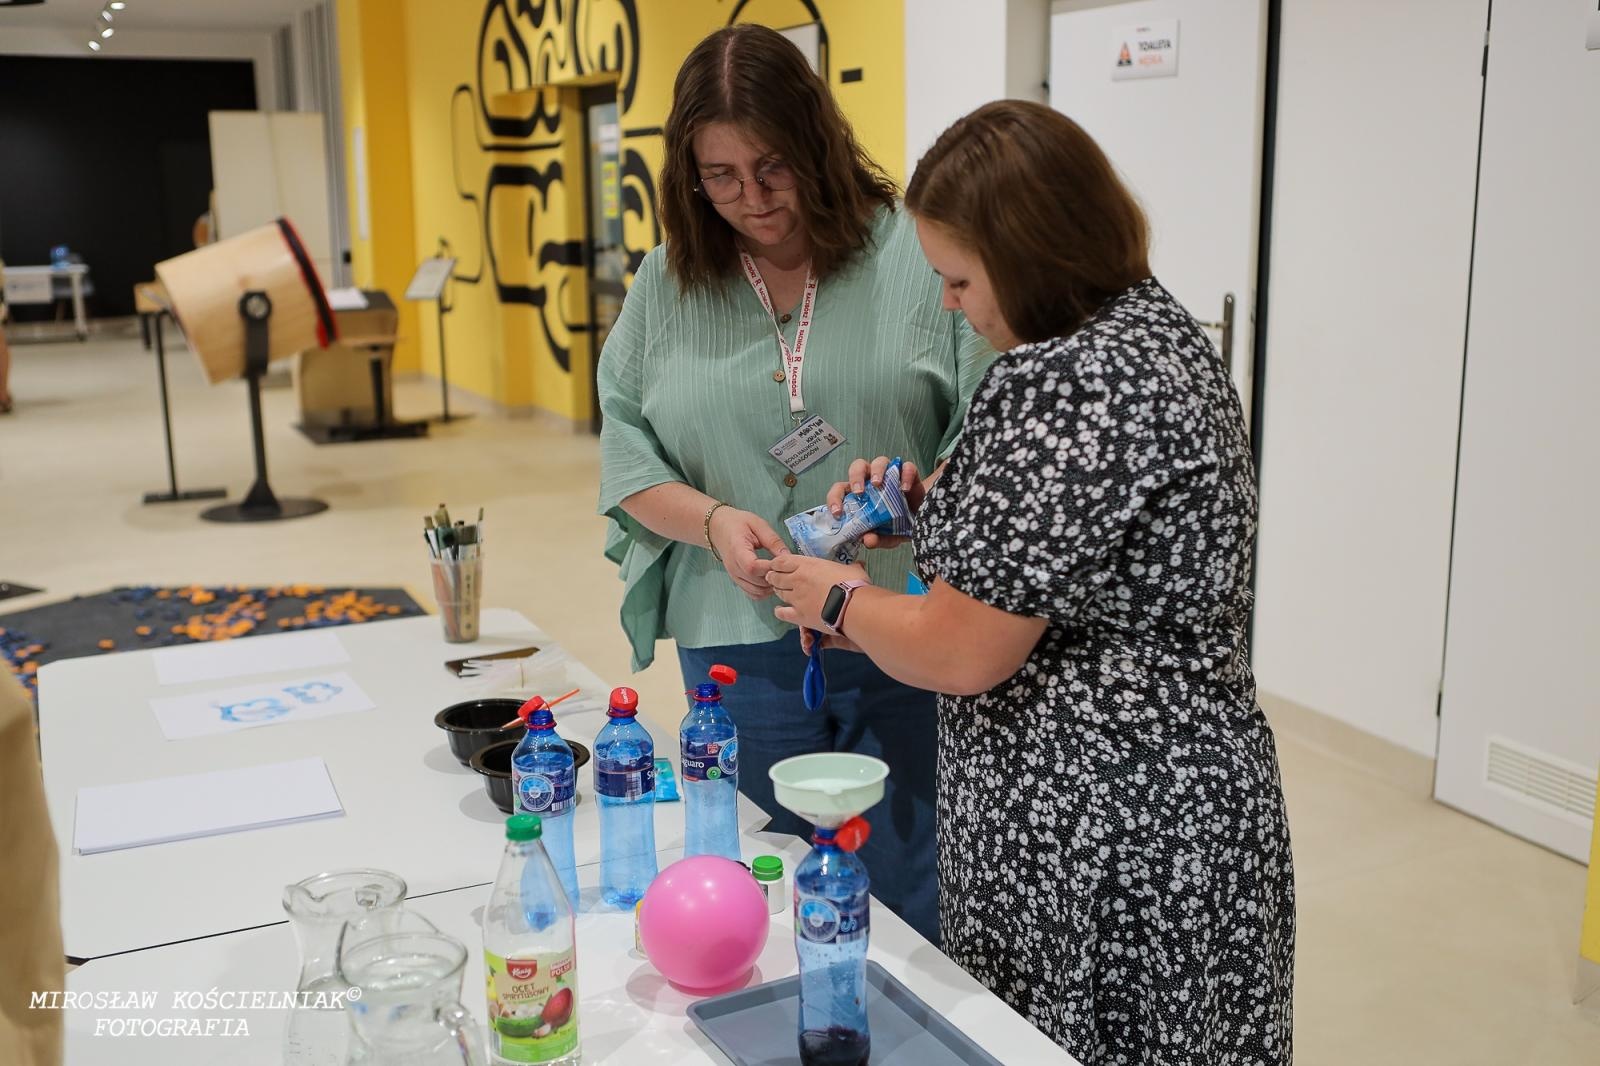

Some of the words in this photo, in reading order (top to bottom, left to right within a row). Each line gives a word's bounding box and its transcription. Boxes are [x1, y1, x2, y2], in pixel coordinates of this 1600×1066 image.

[1138, 38, 1172, 51] TOALETA
[502, 985, 549, 1002] SPIRYTUSOWY
[512, 982, 535, 994] OCET
